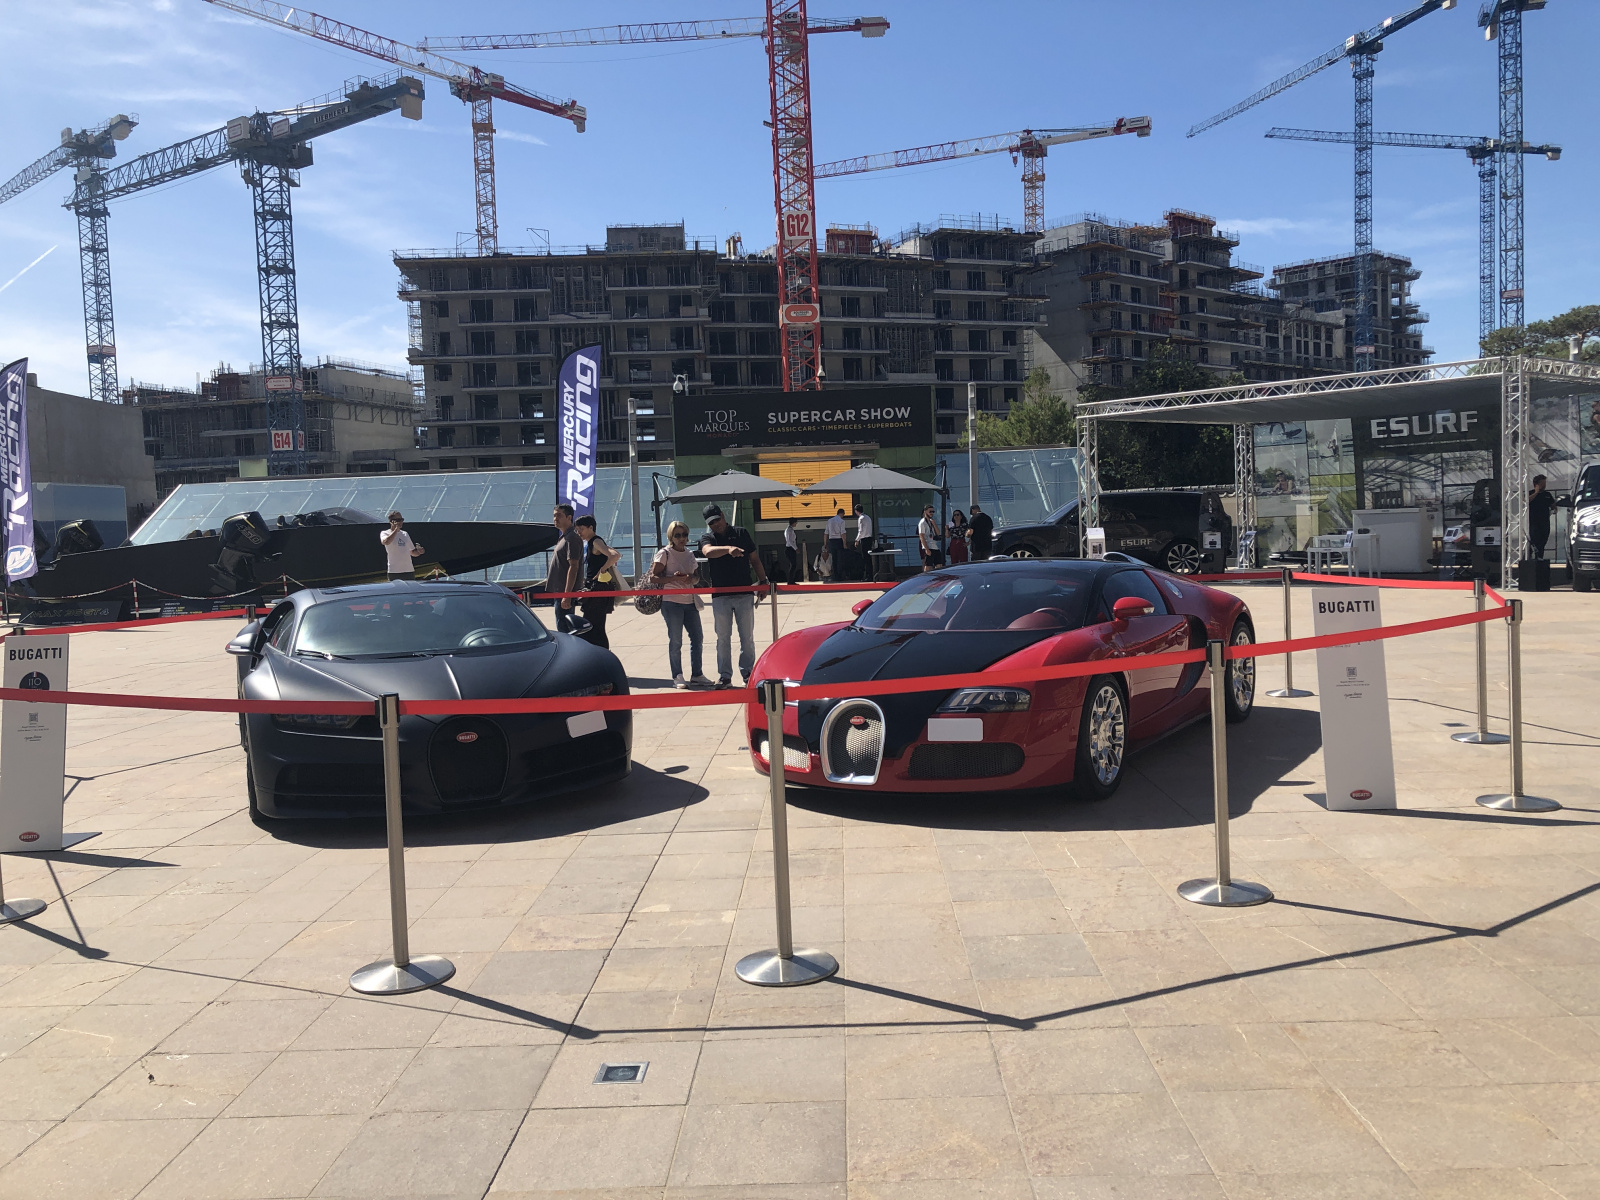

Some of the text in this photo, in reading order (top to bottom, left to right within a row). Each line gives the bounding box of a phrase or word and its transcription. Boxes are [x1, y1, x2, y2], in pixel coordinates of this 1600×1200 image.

[786, 213, 810, 237] G12
[704, 409, 737, 423] TOP
[767, 406, 911, 424] SUPERCAR SHOW
[563, 380, 575, 466] MERCURY
[693, 421, 750, 433] MARQUES
[821, 423, 862, 431] TIMEPIECES
[867, 421, 912, 429] SUPERBOATS
[1370, 410, 1478, 439] ESURF
[273, 432, 291, 449] G14
[1120, 538, 1153, 547] ESURF
[1318, 600, 1375, 614] BUGATTI
[9, 647, 62, 661] BUGATTI
[28, 677, 42, 686] 110
